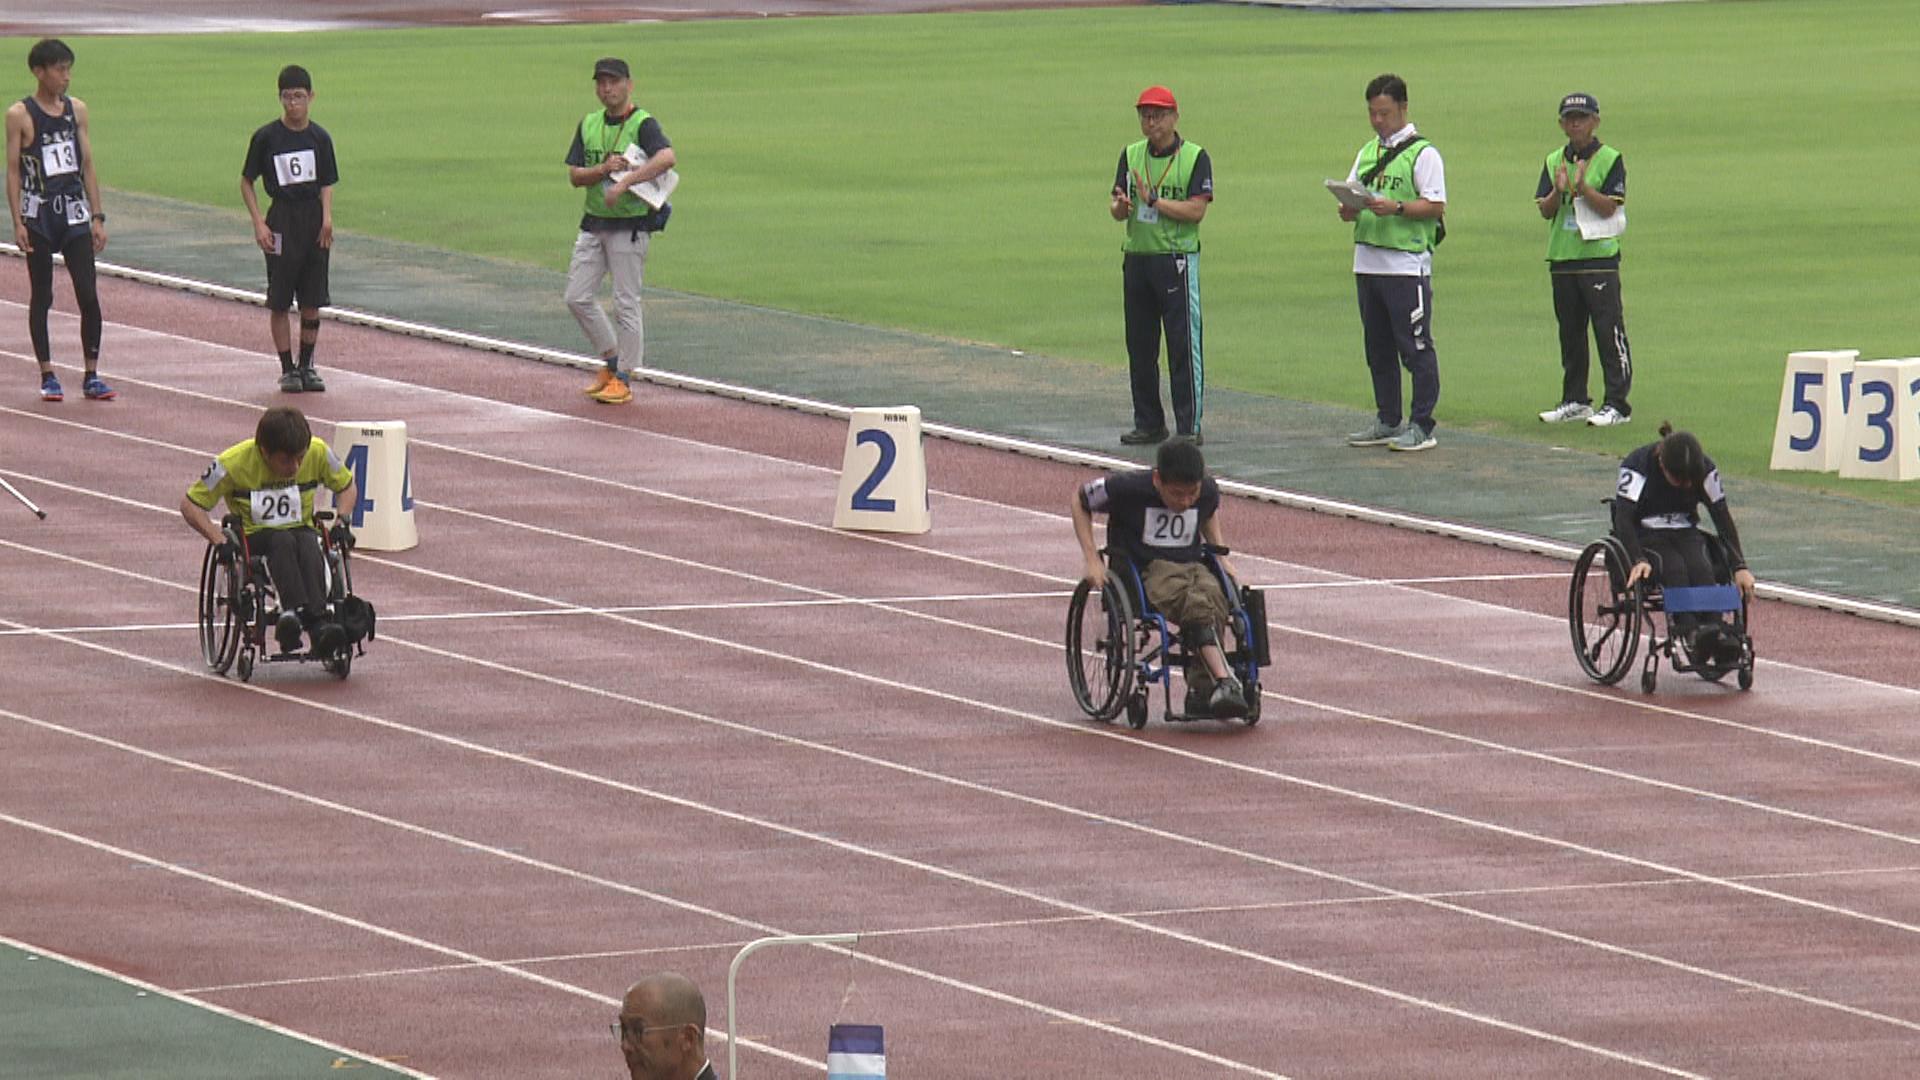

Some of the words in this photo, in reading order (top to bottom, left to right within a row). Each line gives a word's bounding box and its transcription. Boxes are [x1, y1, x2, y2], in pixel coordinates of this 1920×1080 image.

[51, 145, 73, 168] 13
[290, 157, 301, 176] 6
[884, 413, 908, 422] NISHI
[1790, 371, 1824, 452] 5
[1858, 381, 1894, 462] 3
[851, 429, 897, 512] 2
[1619, 471, 1633, 493] 2
[332, 445, 374, 528] 4
[262, 495, 290, 520] 26
[1154, 514, 1185, 539] 20
